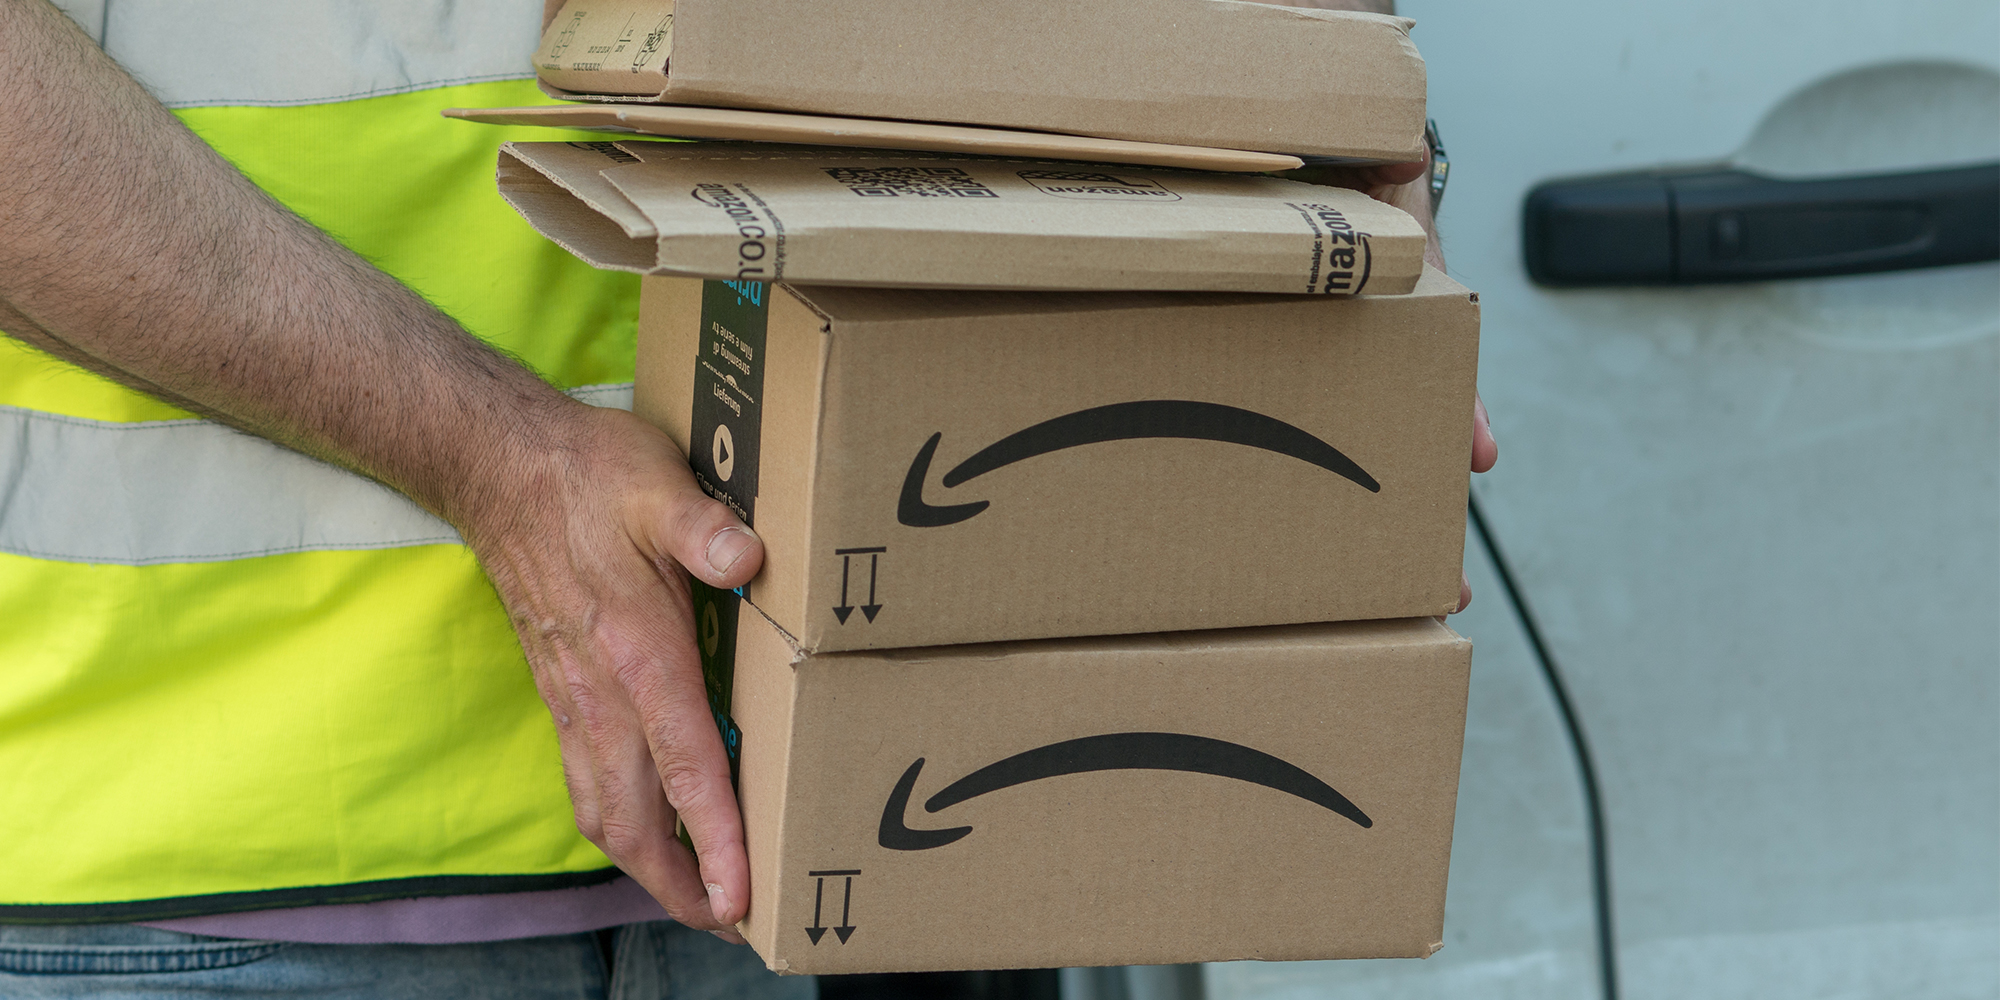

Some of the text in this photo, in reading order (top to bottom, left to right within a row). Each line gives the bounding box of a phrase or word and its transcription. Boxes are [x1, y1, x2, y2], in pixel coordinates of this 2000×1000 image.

[1045, 186, 1168, 198] amazon
[696, 183, 766, 279] amazon.co.u
[1302, 203, 1357, 294] mazon.es
[722, 280, 763, 308] pri
[712, 321, 753, 361] film e serie tv
[712, 341, 751, 376] streaming di
[713, 382, 741, 418] Lieferung
[714, 488, 728, 505] und
[710, 695, 737, 759] ime
